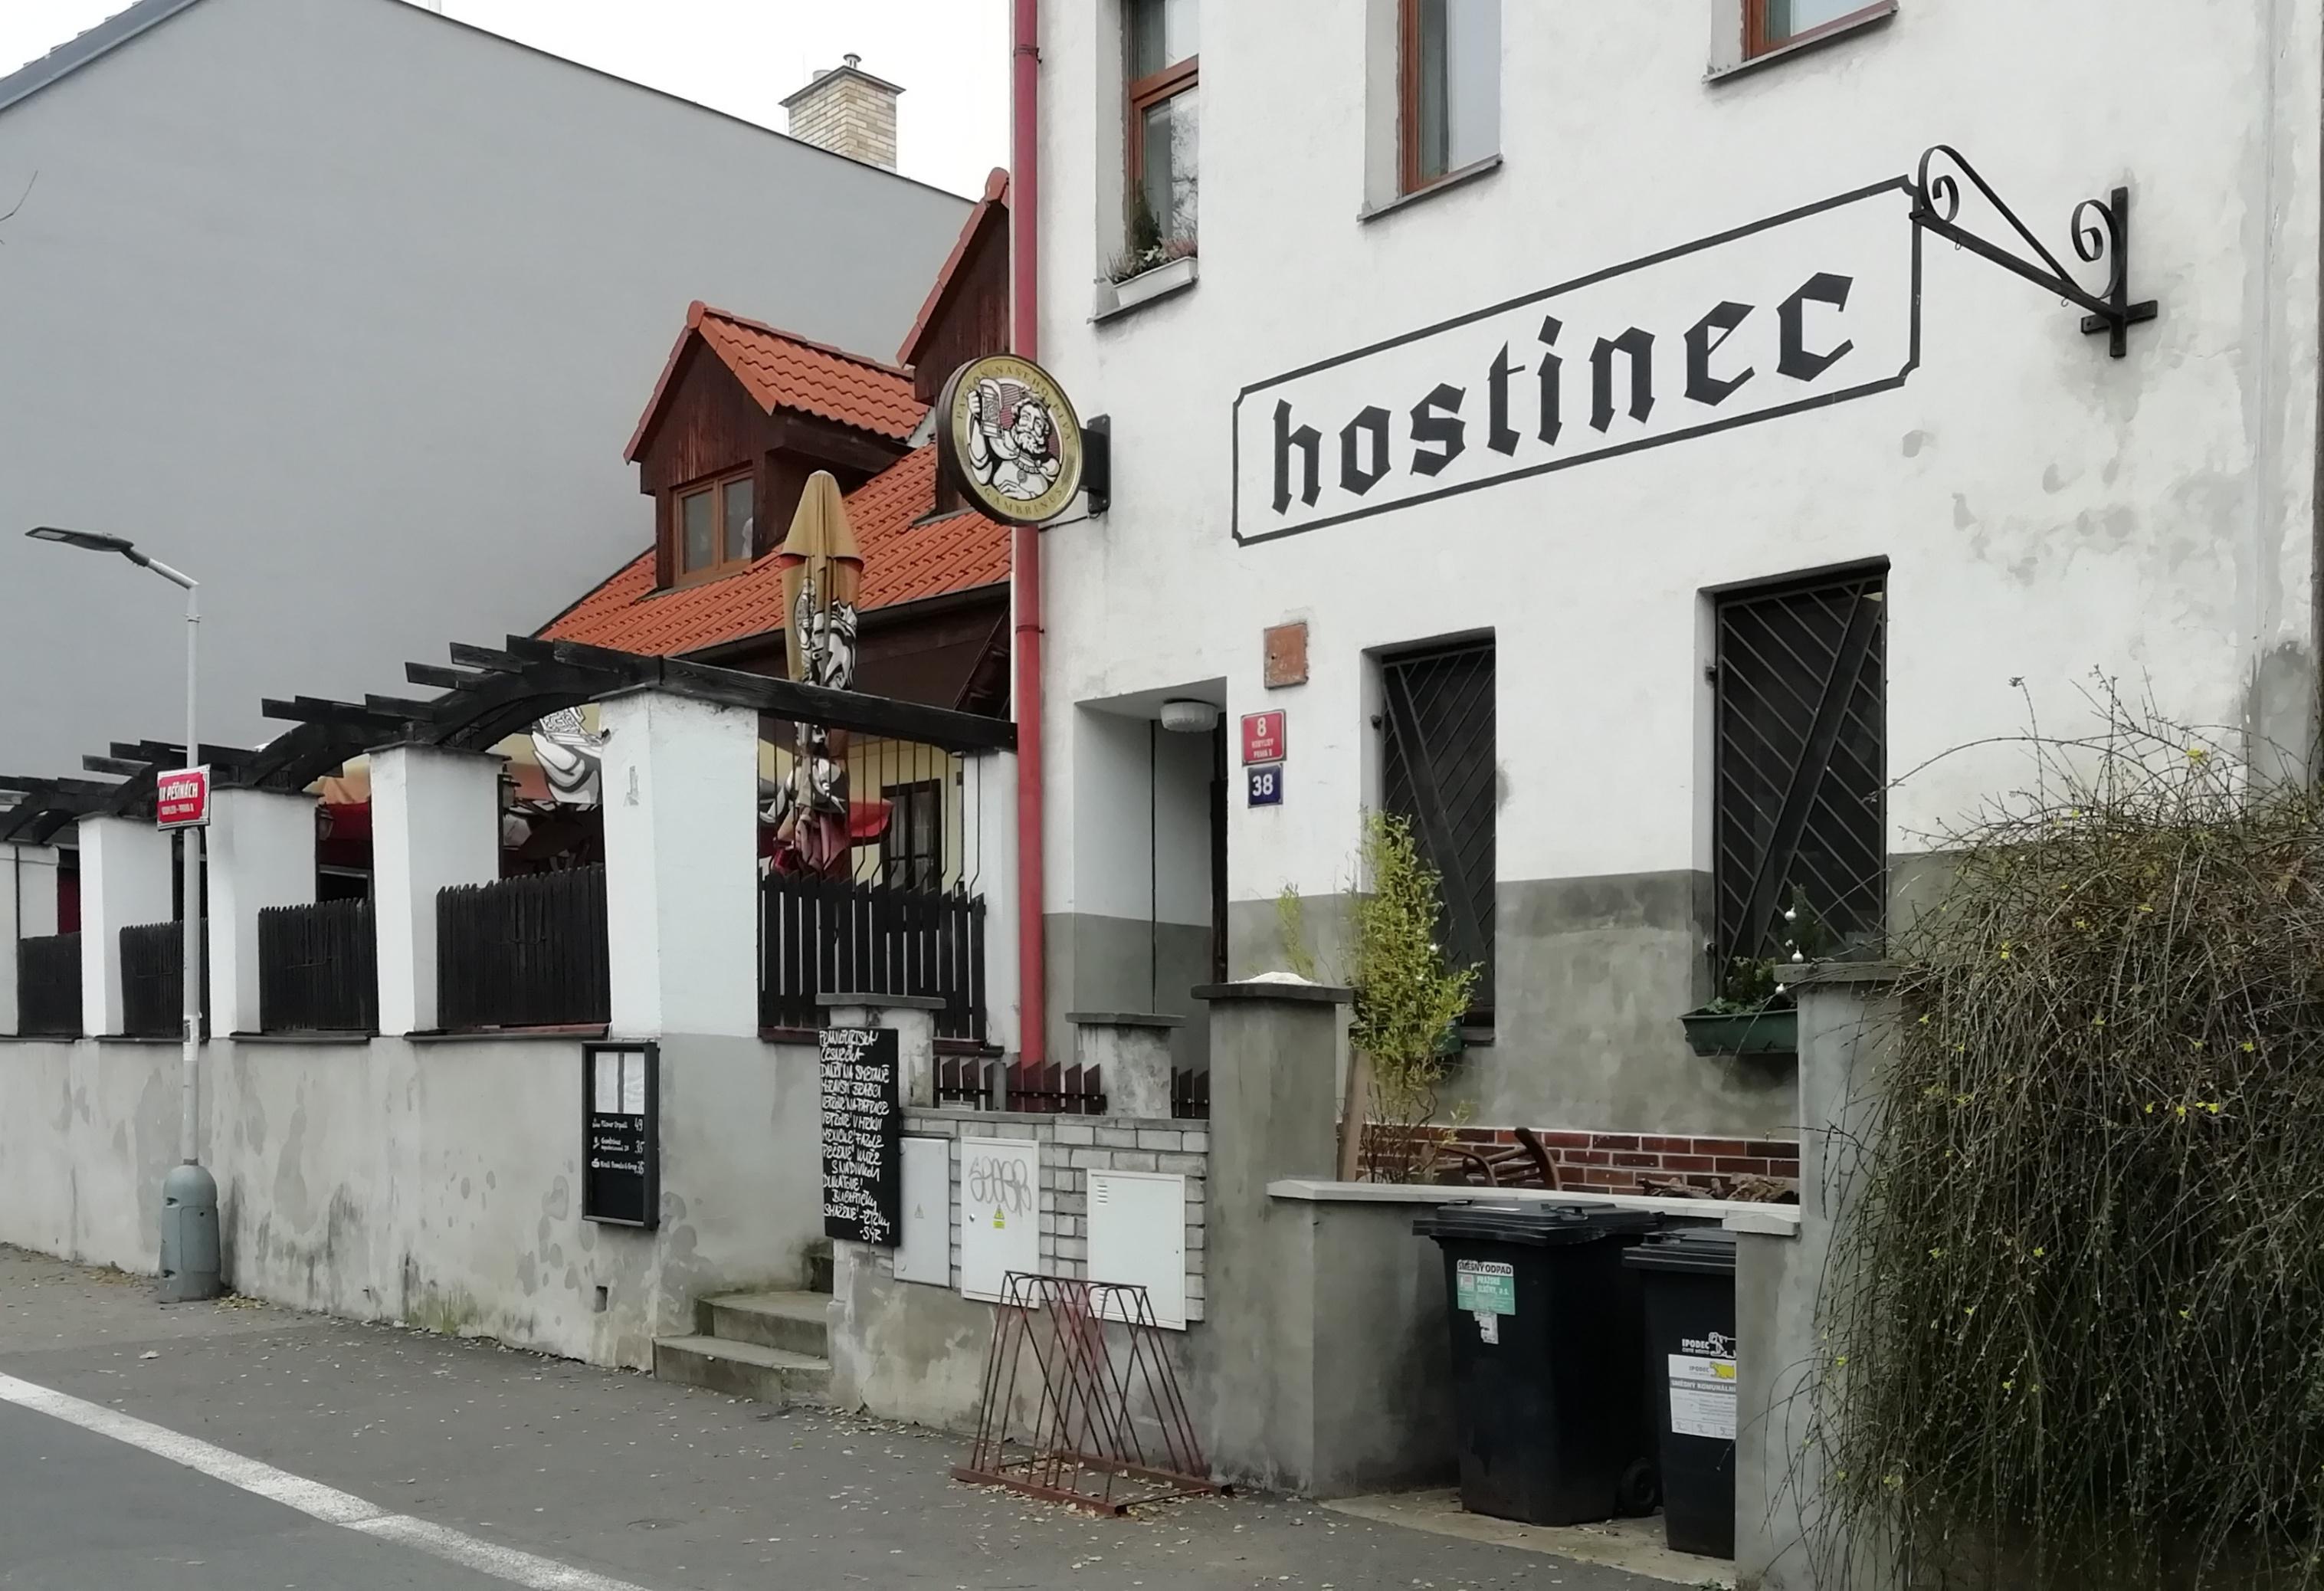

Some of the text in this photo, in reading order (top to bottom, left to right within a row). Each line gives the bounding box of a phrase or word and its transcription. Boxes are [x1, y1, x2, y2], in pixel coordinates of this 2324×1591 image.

[1272, 271, 1854, 515] hostinec
[985, 487, 1063, 515] GAMBRINUS
[1257, 717, 1267, 737] 8
[1252, 773, 1273, 796] 38
[634, 1117, 643, 1132] 49
[1485, 1264, 1512, 1274] ODPAD
[1682, 1338, 1709, 1350] IPODEC
